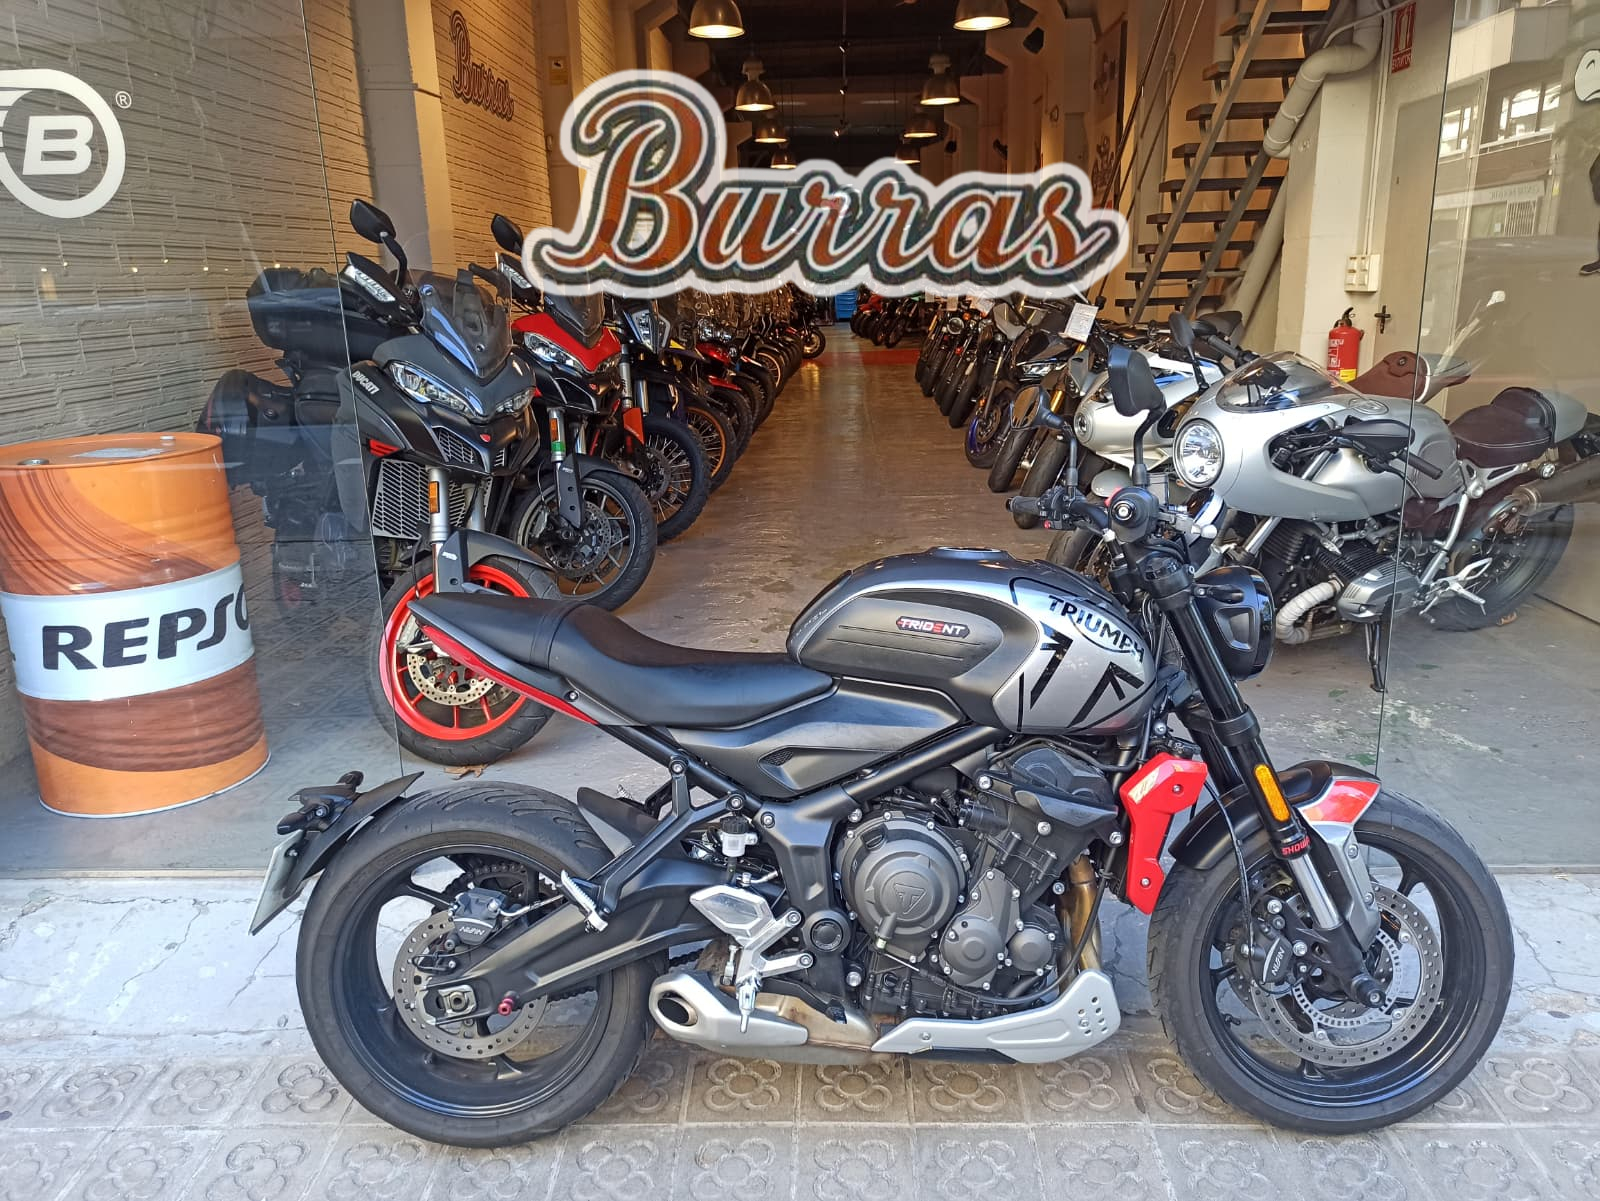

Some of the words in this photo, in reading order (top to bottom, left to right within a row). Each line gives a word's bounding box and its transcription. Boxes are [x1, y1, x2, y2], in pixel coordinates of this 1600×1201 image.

[450, 10, 514, 121] Burras
[352, 370, 380, 395] DUCATI
[899, 617, 966, 636] TRIDENT
[1048, 595, 1145, 663] TRIUMPH
